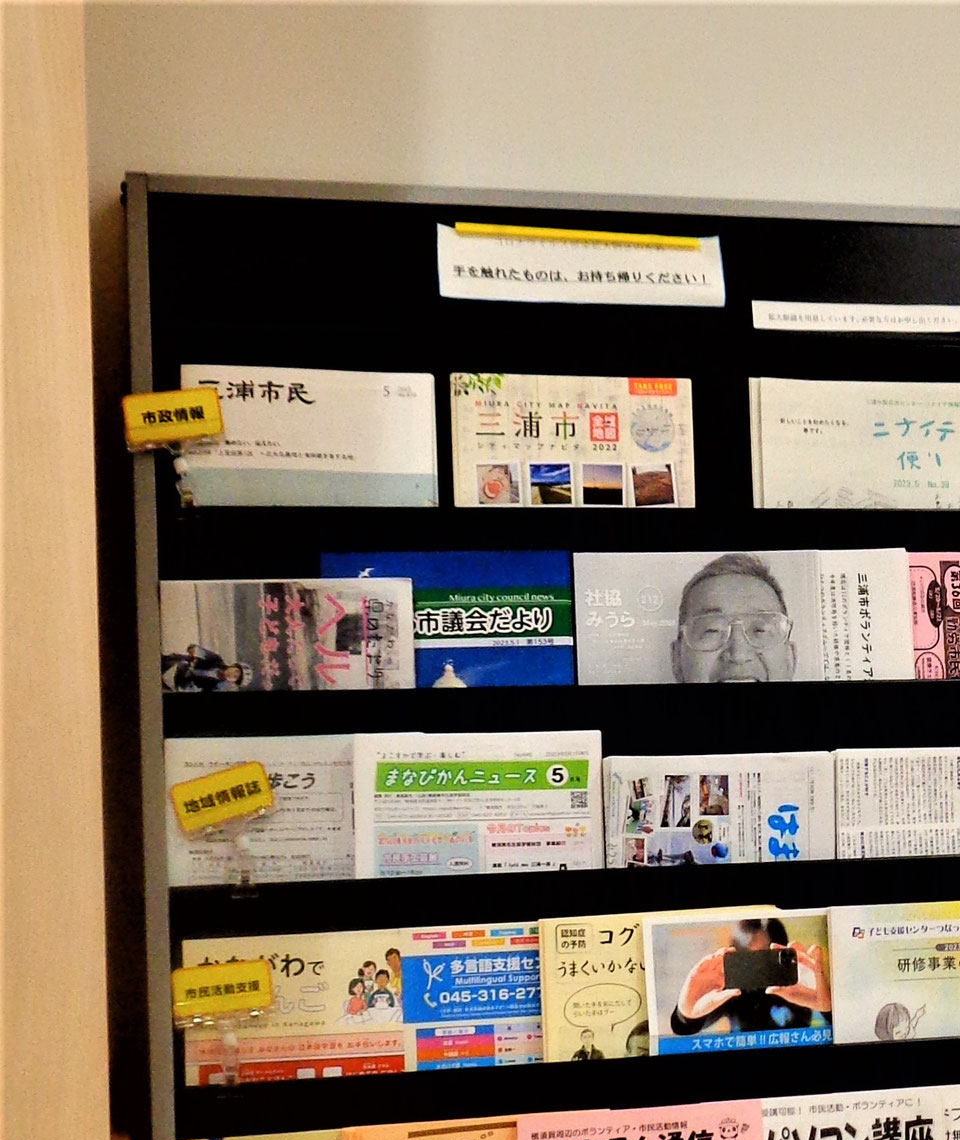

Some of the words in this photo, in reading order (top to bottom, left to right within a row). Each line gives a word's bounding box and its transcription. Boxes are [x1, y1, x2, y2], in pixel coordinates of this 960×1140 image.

[475, 400, 509, 408] MIURA
[141, 405, 206, 425] 市政情報
[476, 411, 579, 440] 三浦市
[872, 418, 955, 441] ニナイテ
[593, 443, 617, 451] 2022
[897, 451, 942, 470] 便り
[449, 593, 476, 601] Miura
[477, 593, 495, 602] city
[496, 592, 530, 601] council
[584, 588, 622, 607] 社協
[586, 611, 635, 628] みうら
[857, 572, 874, 680] 三浦市ボランティア
[385, 767, 537, 787] まなびかんニュース
[551, 767, 564, 783] 5
[183, 779, 262, 814] 地域情報誌
[561, 928, 586, 938] 認知症
[598, 923, 640, 947] コグ
[561, 940, 587, 949] の予防
[455, 976, 506, 985] Multilingual
[508, 974, 540, 983] Suppor
[185, 980, 261, 999] 市民活動支援
